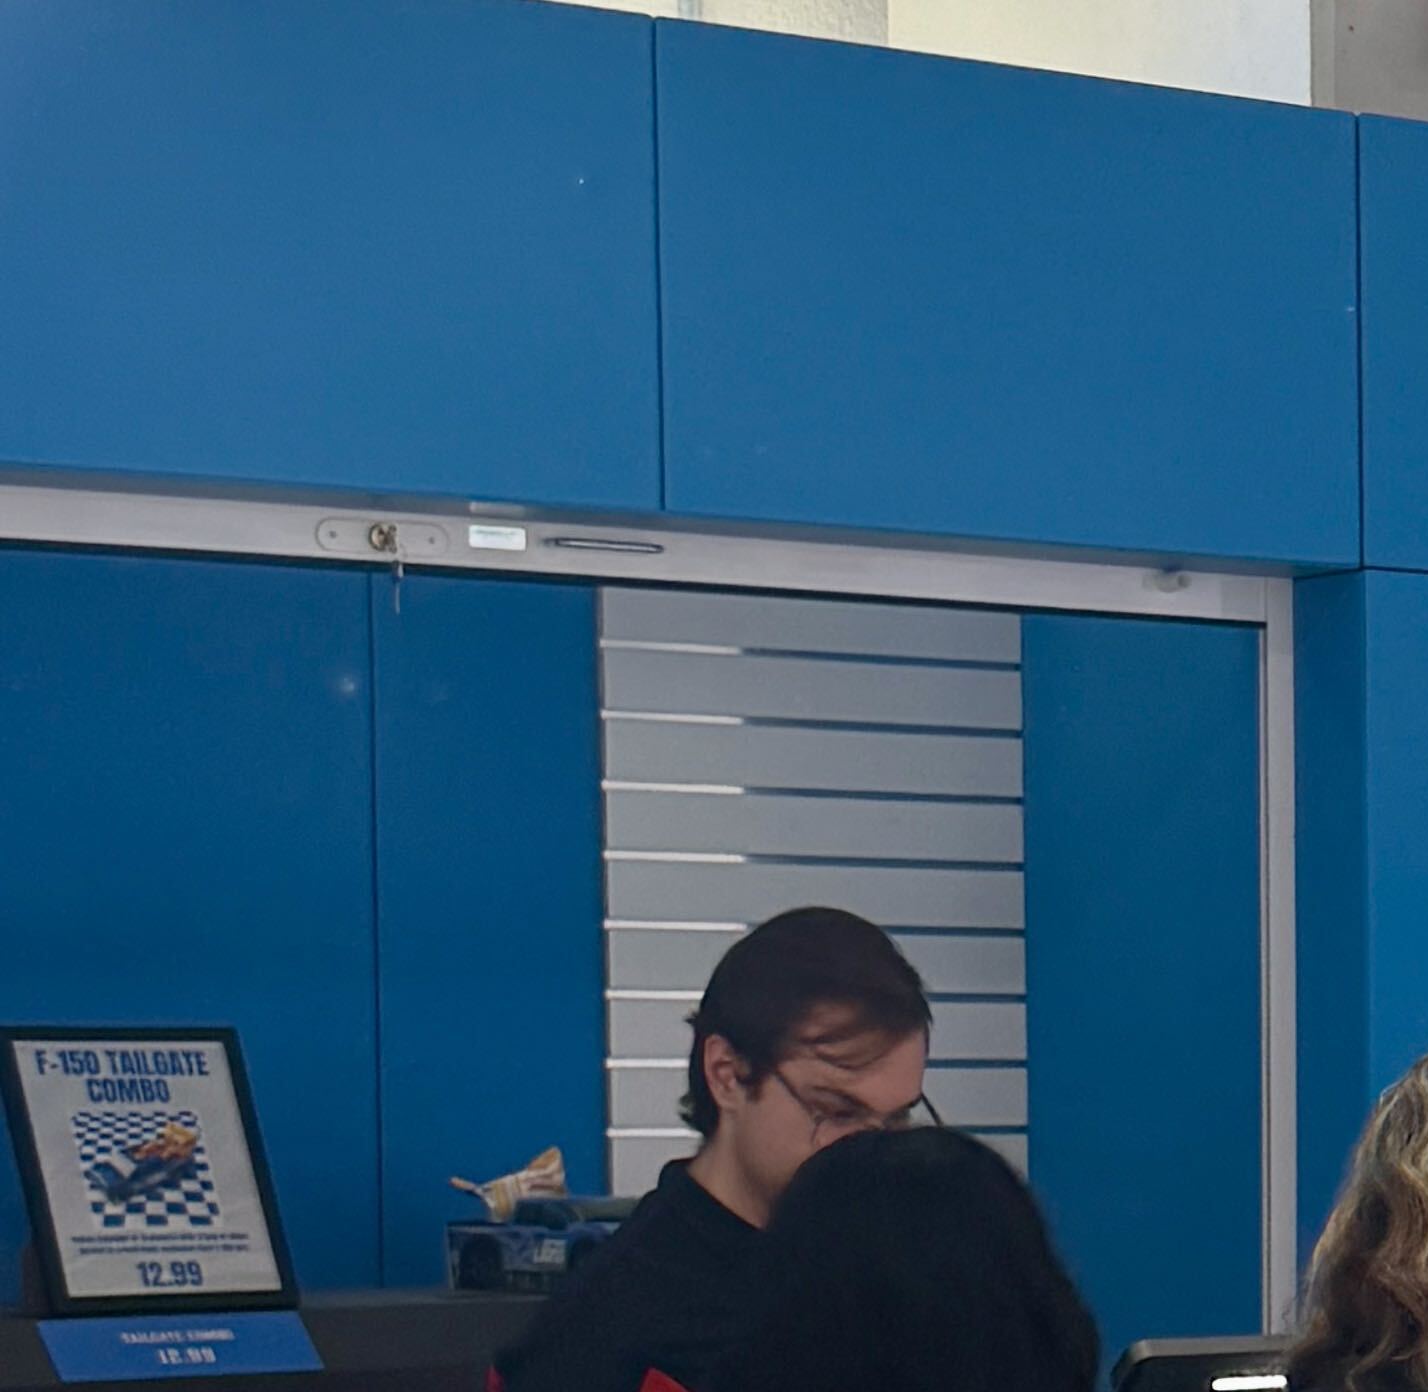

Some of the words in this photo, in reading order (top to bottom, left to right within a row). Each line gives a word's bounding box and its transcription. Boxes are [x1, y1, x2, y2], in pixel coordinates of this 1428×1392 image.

[35, 1050, 101, 1076] F-150
[105, 1050, 210, 1076] TAILGATE
[86, 1077, 171, 1104] COMBO
[136, 1260, 204, 1287] 12.99
